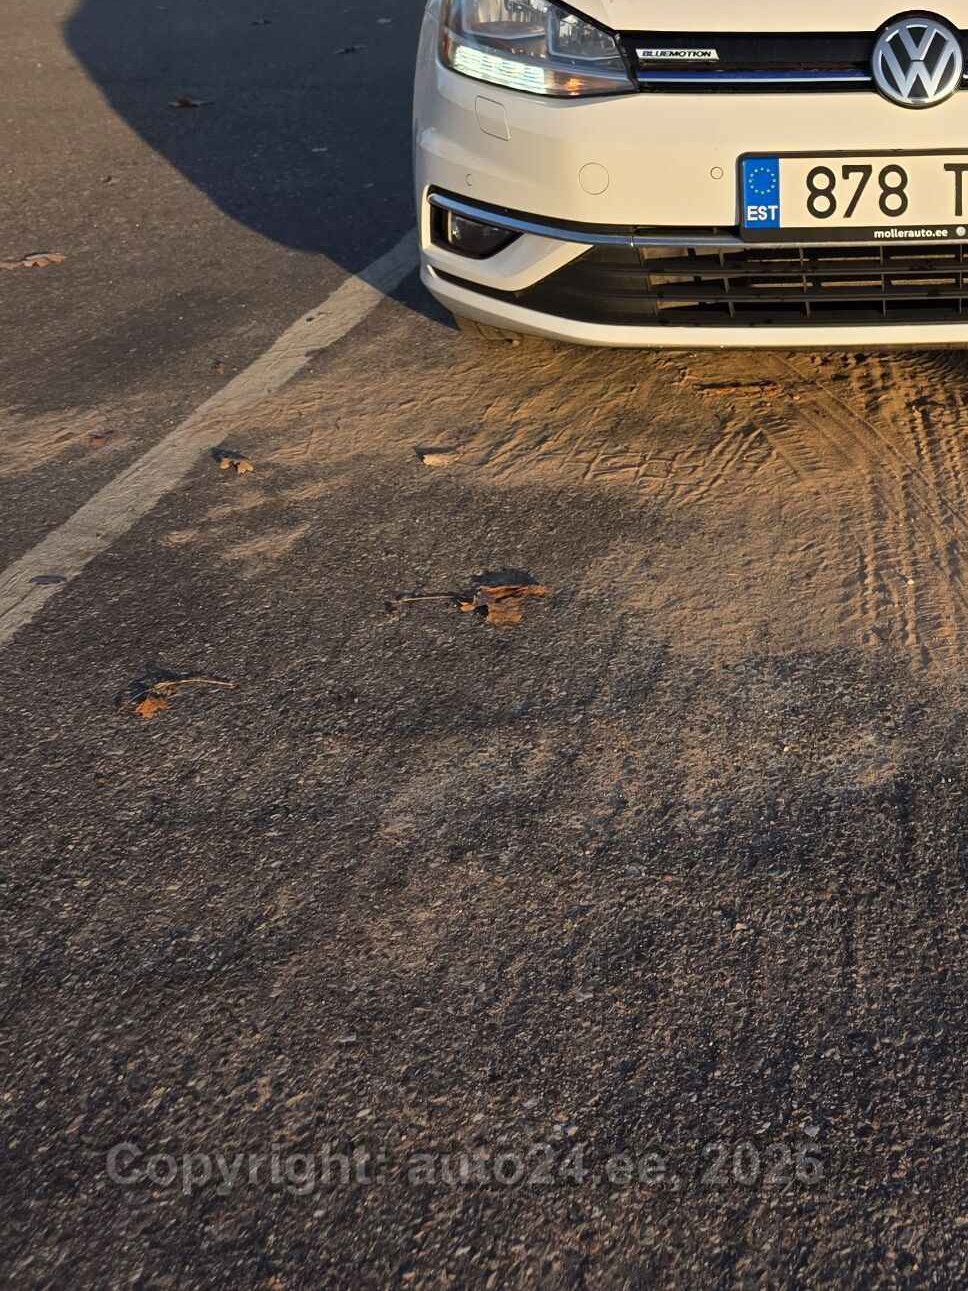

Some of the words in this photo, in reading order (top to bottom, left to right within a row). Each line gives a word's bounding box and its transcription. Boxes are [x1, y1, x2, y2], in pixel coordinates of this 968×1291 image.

[641, 50, 712, 59] BLUEMOTION
[873, 16, 965, 106] VW
[806, 163, 909, 220] 878
[747, 205, 778, 221] EST
[874, 226, 948, 239] mollerauto.ee
